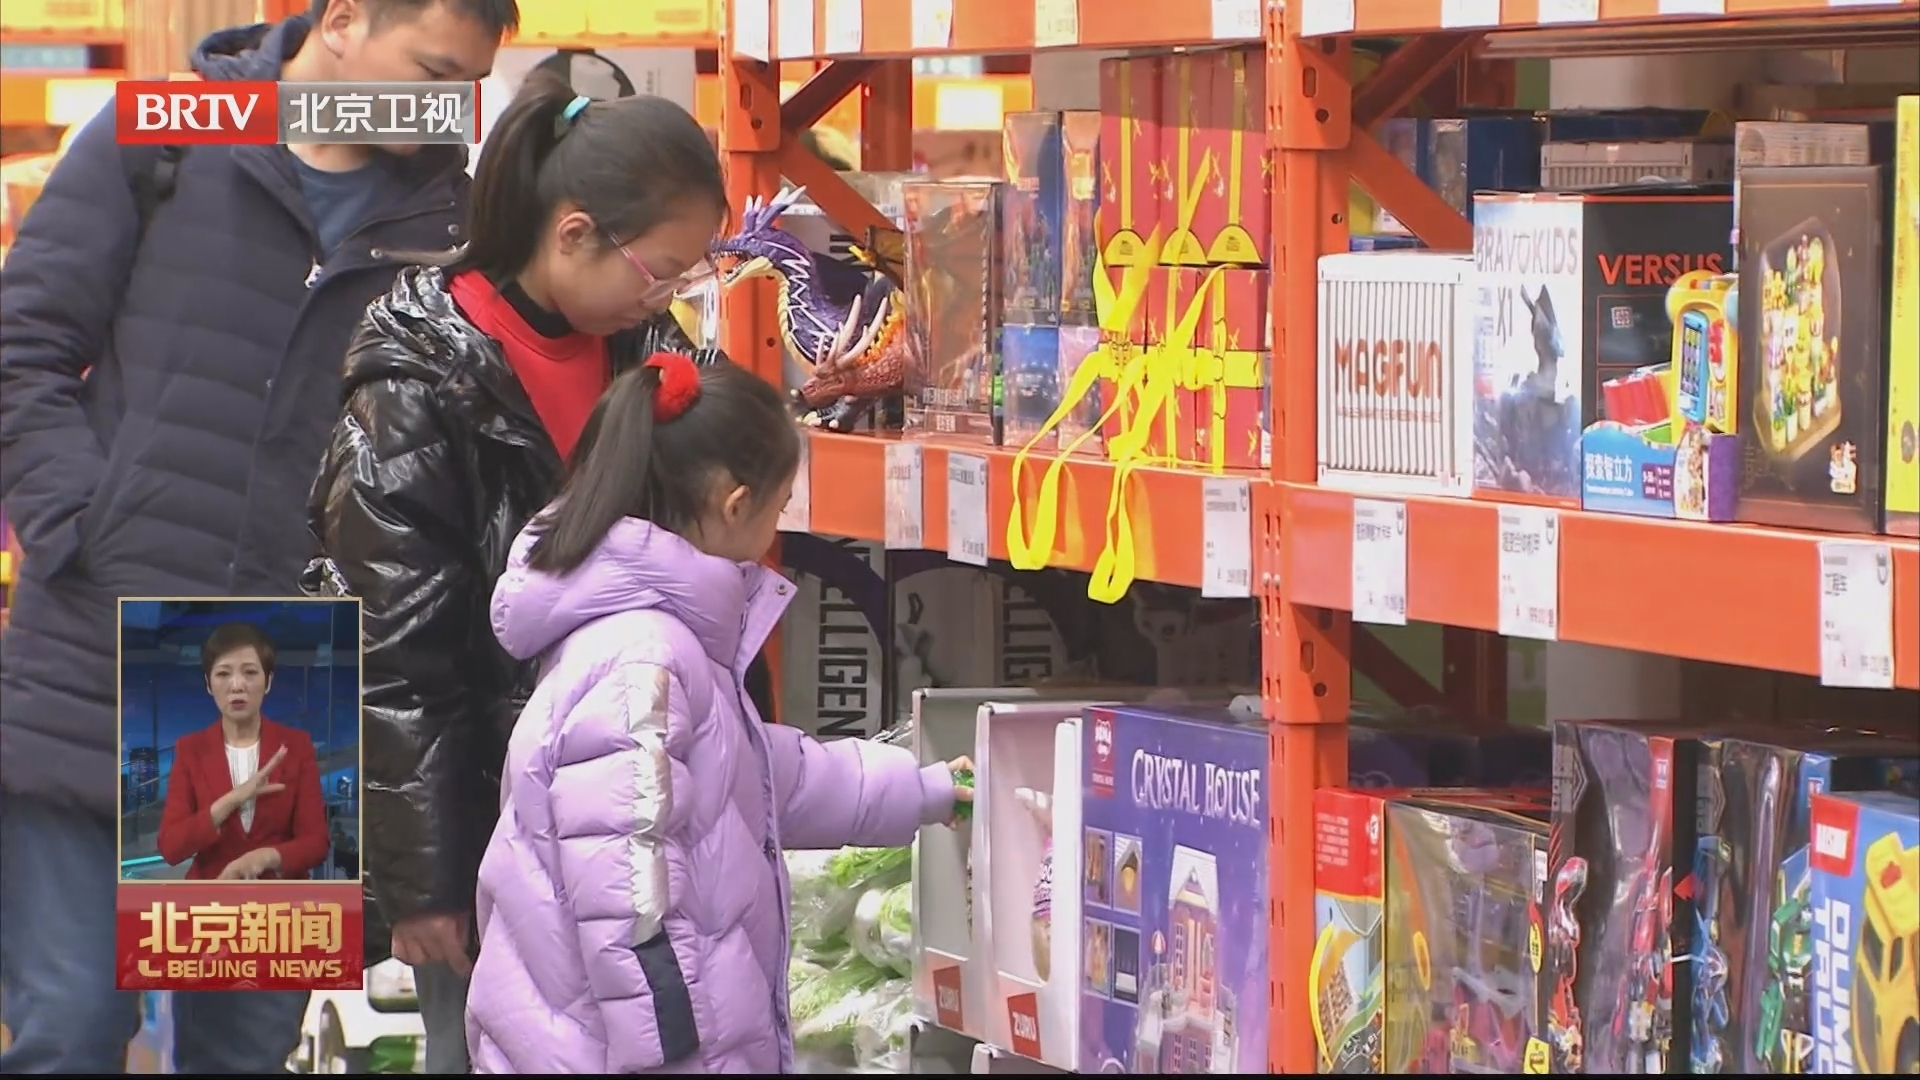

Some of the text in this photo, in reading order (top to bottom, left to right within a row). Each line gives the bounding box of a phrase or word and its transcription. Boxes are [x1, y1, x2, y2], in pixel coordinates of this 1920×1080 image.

[1335, 338, 1442, 400] MAGFUN
[1131, 748, 1261, 827] CRYSTAL HOUSE
